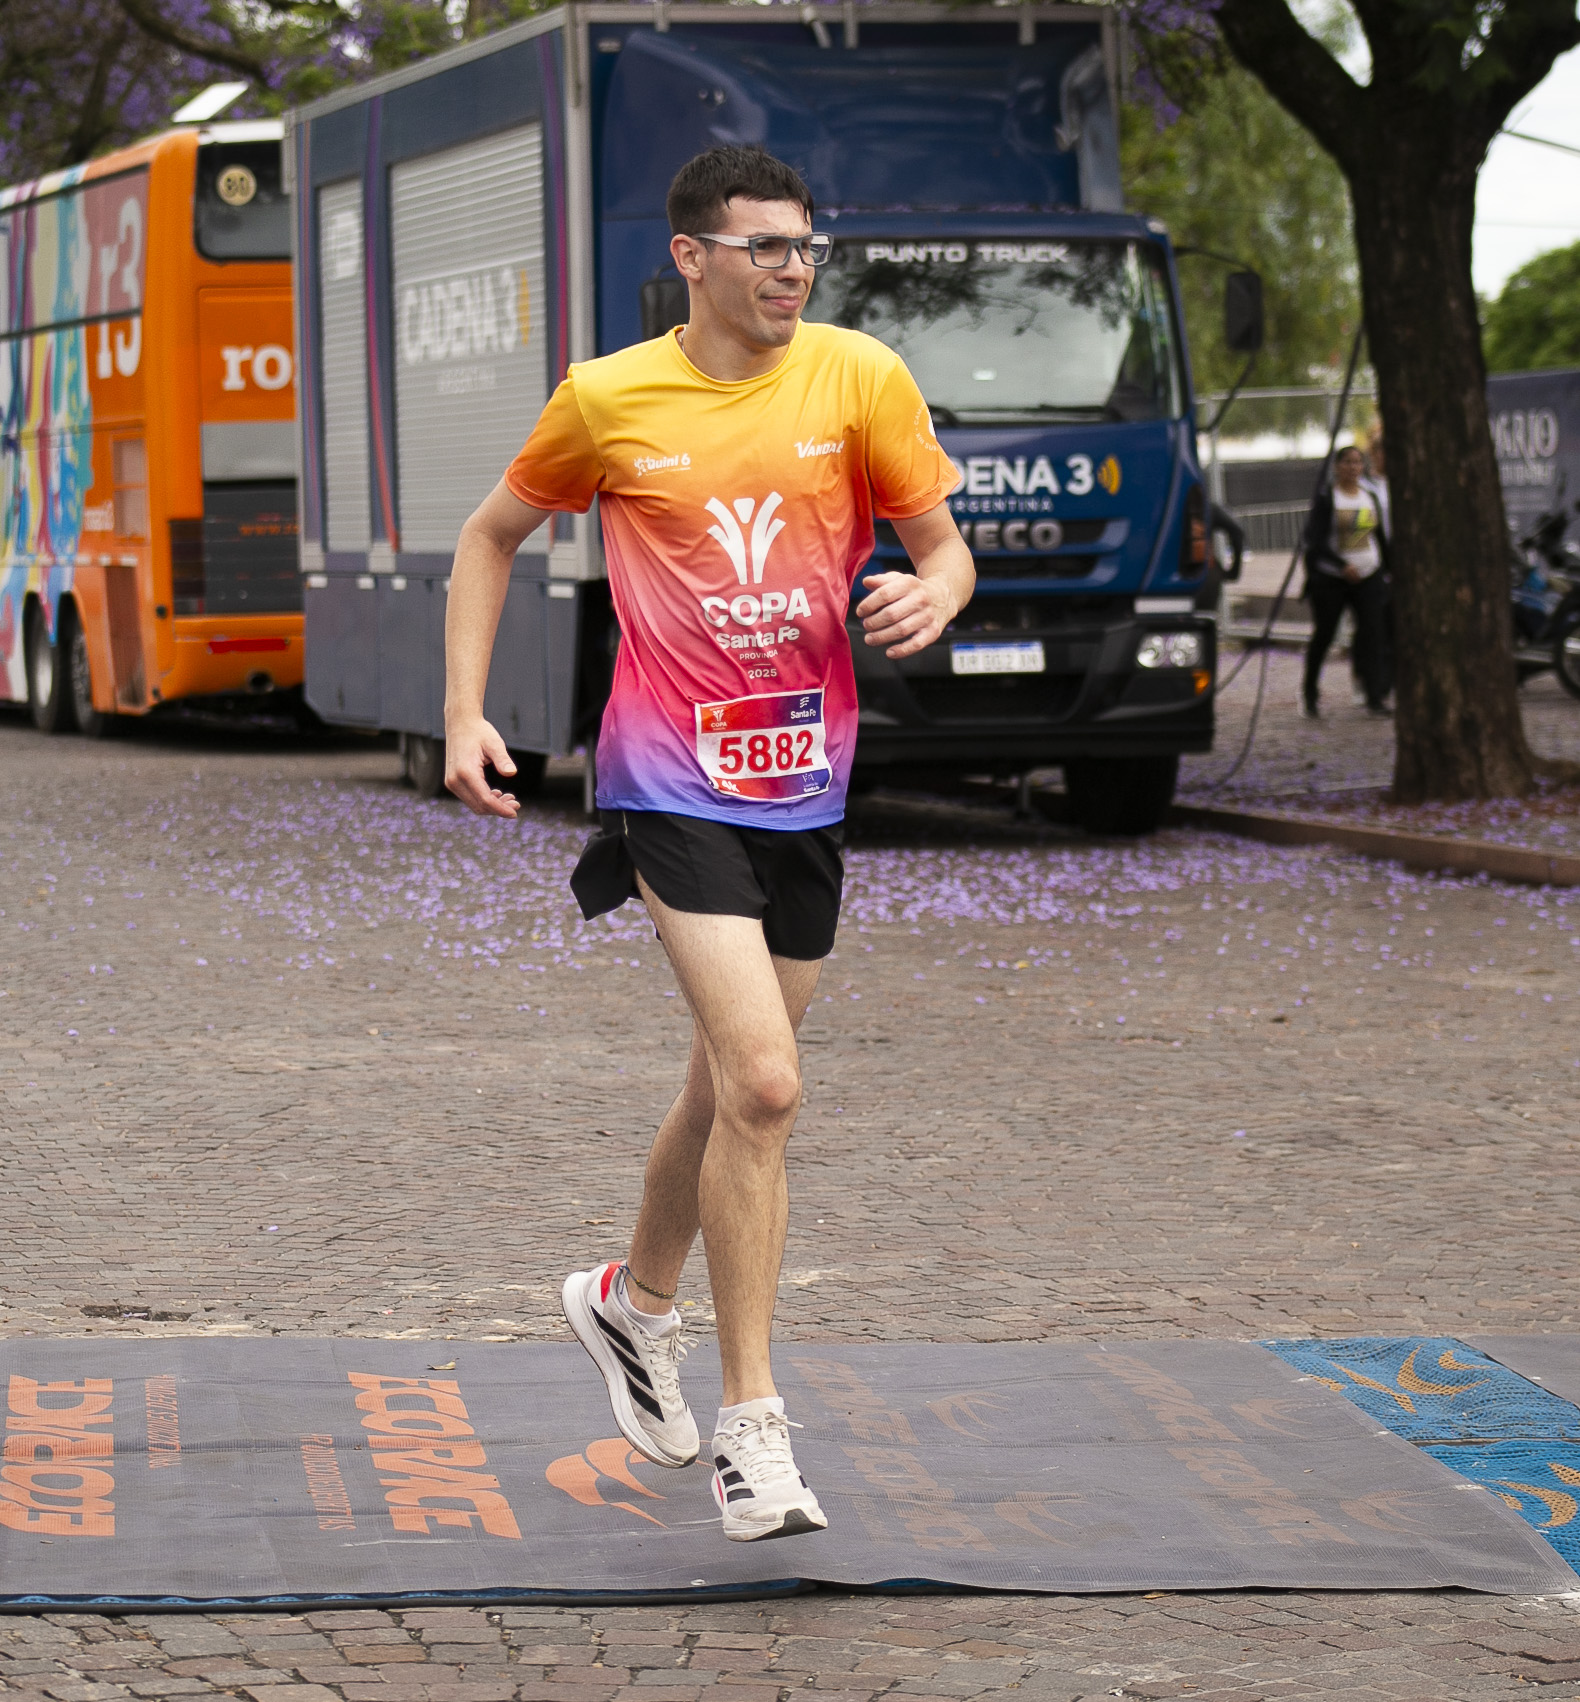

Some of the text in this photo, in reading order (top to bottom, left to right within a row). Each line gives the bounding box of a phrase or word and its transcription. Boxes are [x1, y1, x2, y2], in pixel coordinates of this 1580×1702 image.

[865, 242, 1069, 263] PUNTO TRUCK
[681, 452, 691, 466] 6
[1065, 453, 1096, 495] 3
[701, 587, 812, 628] COPA
[716, 625, 800, 650] Santa Fe
[739, 649, 778, 660] PROVINCIA
[748, 668, 778, 680] 2025
[790, 708, 817, 720] Santa Fe
[718, 730, 814, 775] 5882
